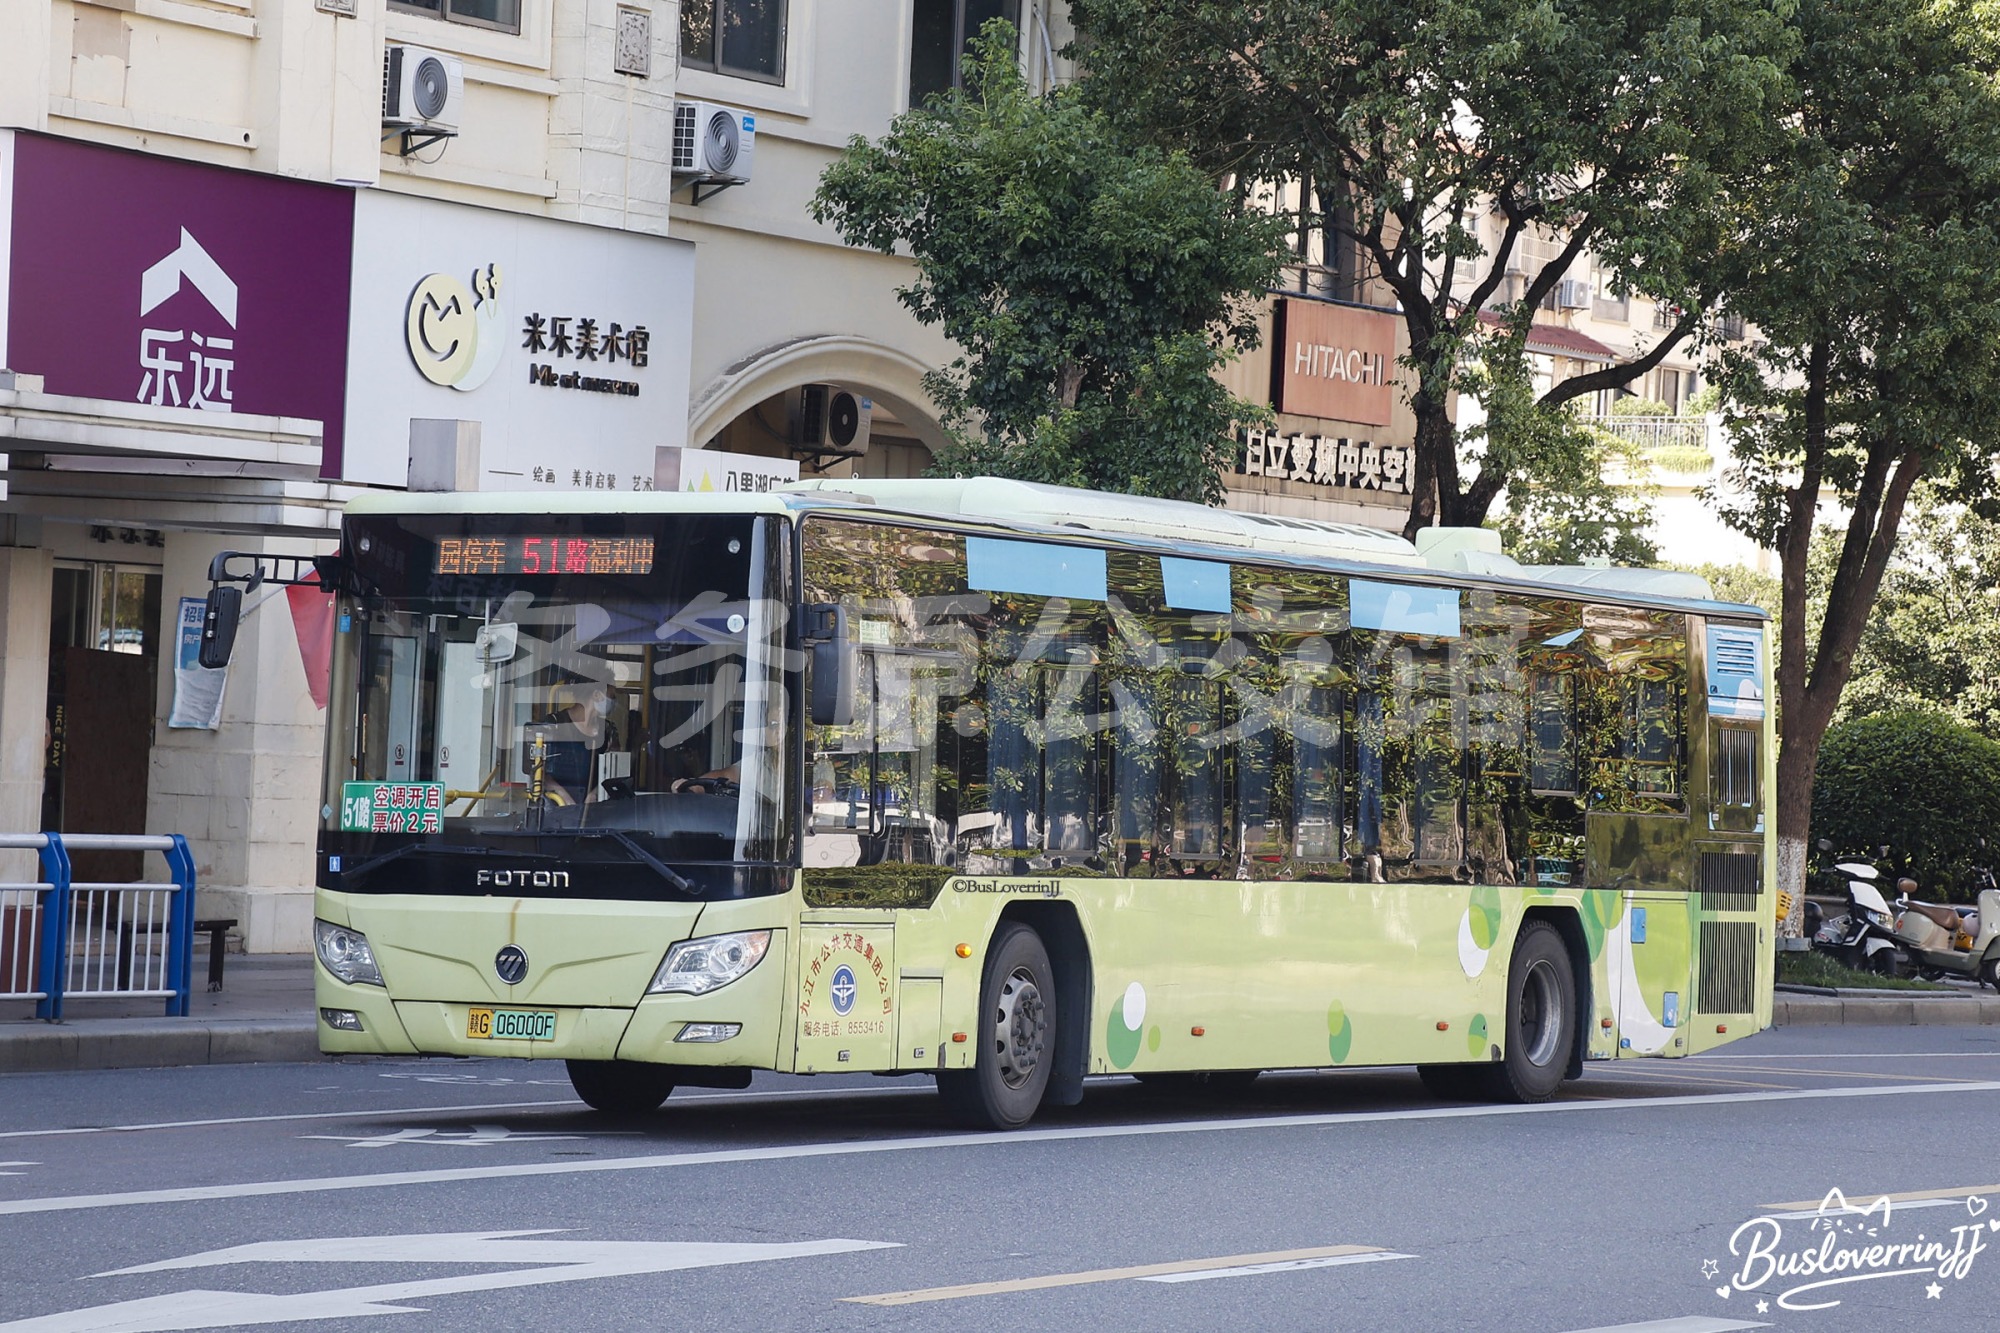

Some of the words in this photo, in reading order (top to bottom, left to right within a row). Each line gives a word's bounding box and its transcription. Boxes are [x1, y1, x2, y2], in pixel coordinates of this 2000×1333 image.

[522, 312, 650, 367] 米乐美术馆
[136, 328, 235, 413] 乐远
[1294, 342, 1385, 387] HITACHI
[532, 465, 556, 484] 绘画
[571, 469, 617, 490] 美育启蒙
[55, 704, 64, 734] NICE
[52, 740, 61, 767] DAY
[373, 785, 441, 810] 空调开启
[344, 797, 370, 829] 51路
[372, 811, 439, 834] 票价2元
[476, 869, 570, 888] FOTON
[800, 931, 892, 1017] 九江市公共交通集团公司
